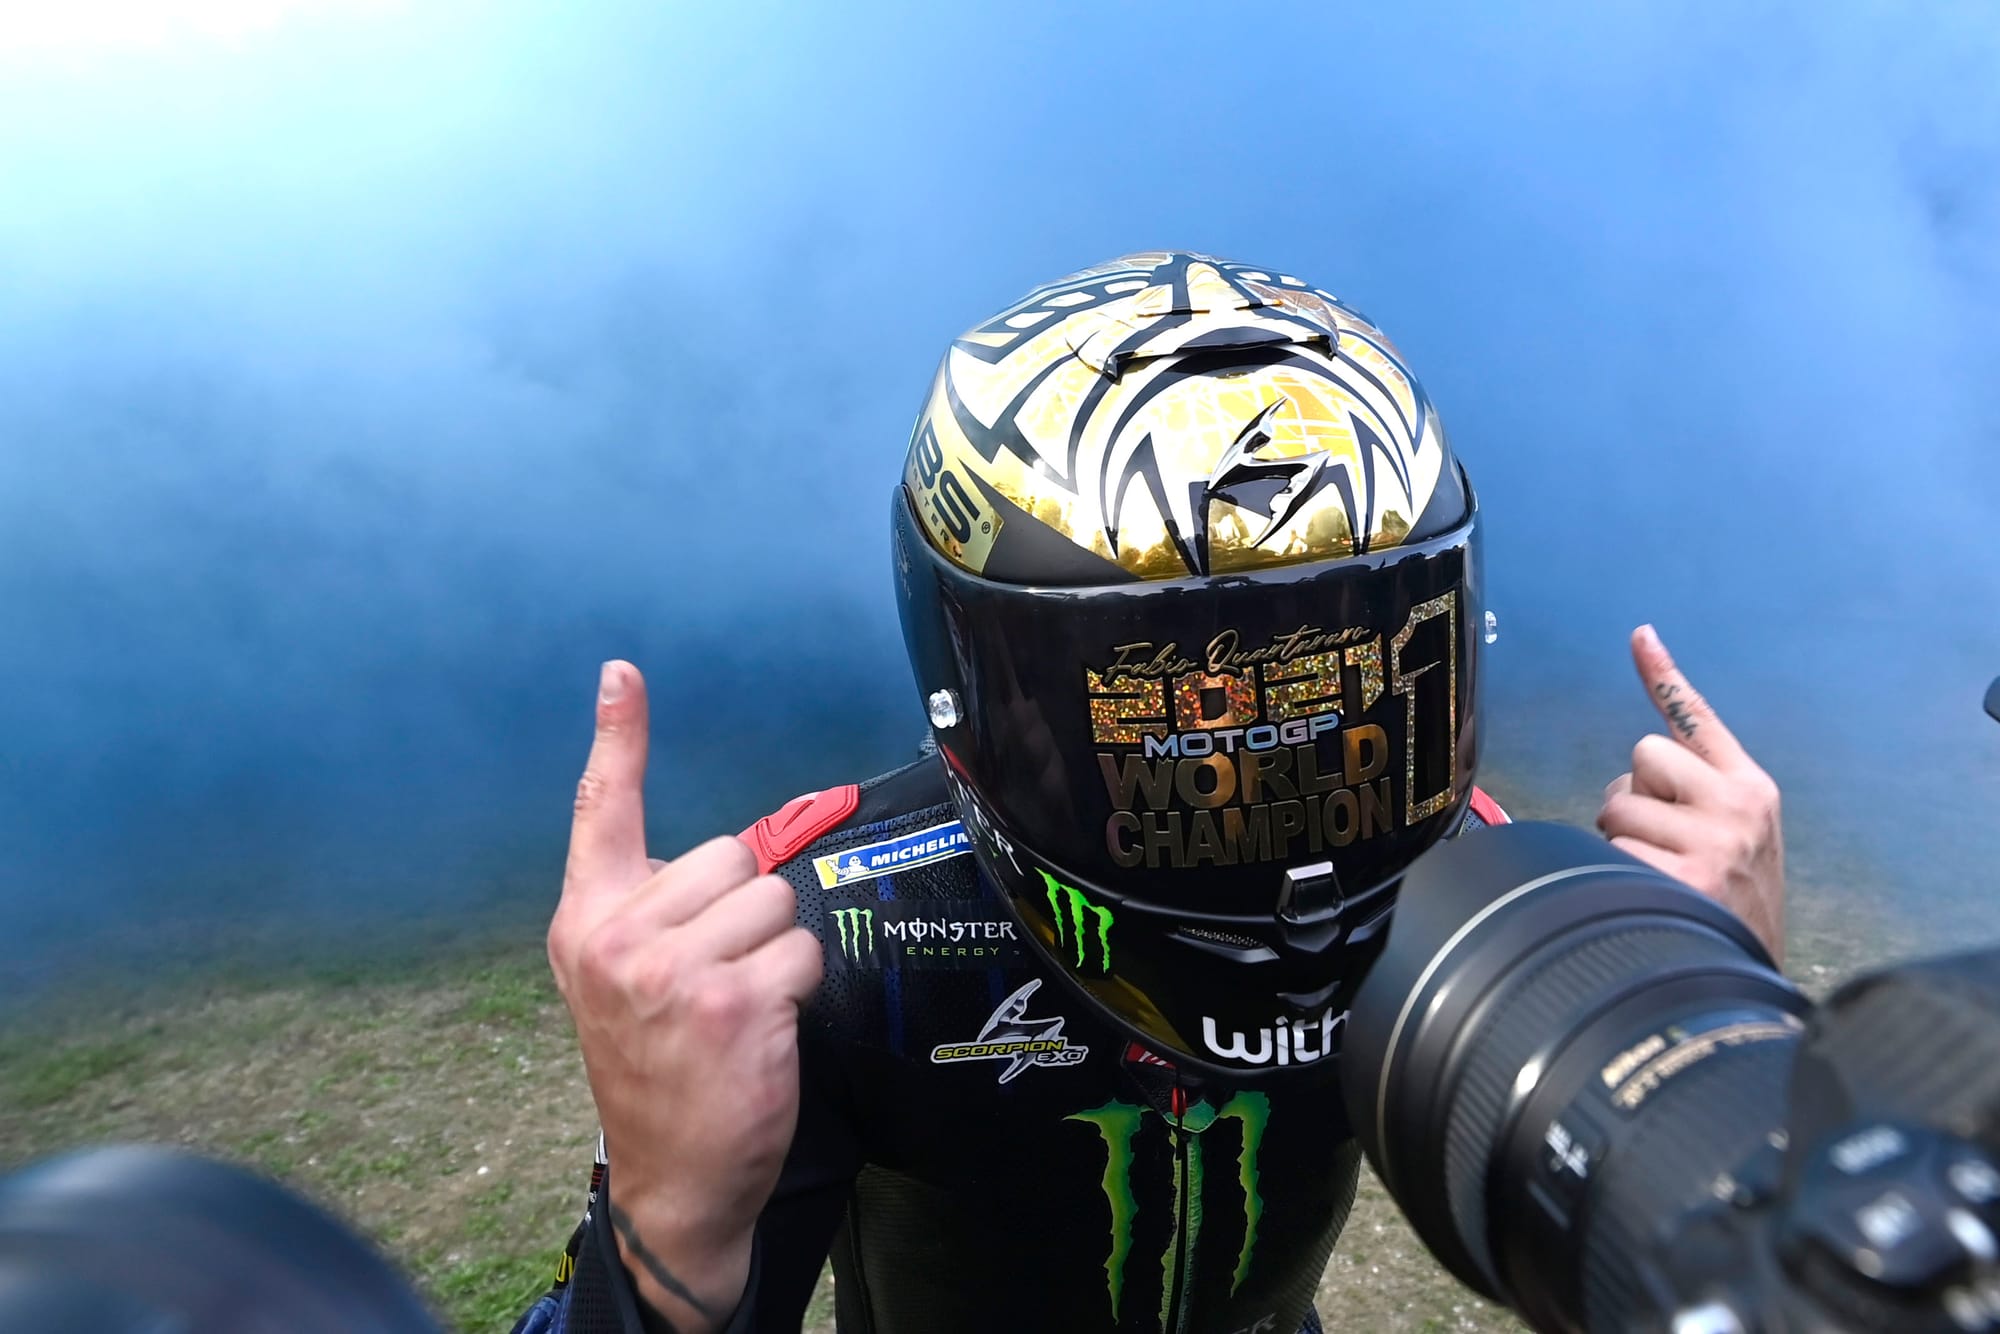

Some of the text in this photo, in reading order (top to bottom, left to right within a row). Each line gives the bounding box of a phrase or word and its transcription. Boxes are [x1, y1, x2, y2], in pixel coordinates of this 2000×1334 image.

[1106, 642, 1198, 683] Fabio
[1086, 633, 1386, 744] 2021
[1144, 713, 1339, 758] MOTOGP
[1096, 723, 1389, 811] WORLD
[1105, 776, 1394, 869] CHAMPION
[871, 832, 969, 867] MICHELIN
[883, 917, 1018, 943] MONSTER
[906, 946, 1000, 956] ENERGY
[935, 1040, 1064, 1060] SCORPION
[1036, 1051, 1082, 1062] EXO
